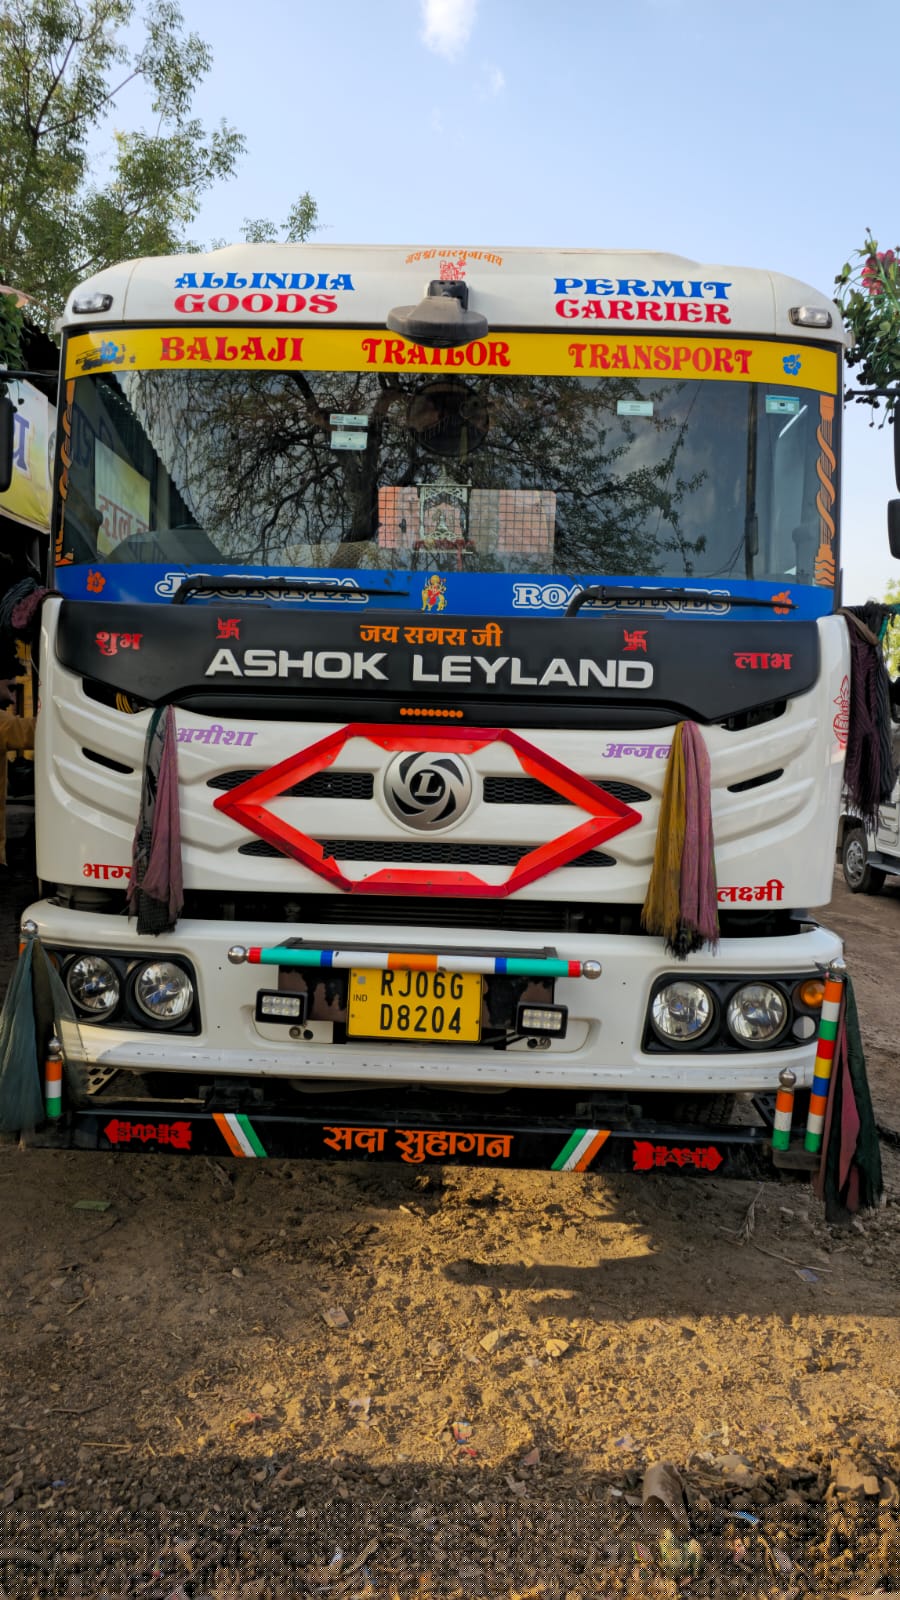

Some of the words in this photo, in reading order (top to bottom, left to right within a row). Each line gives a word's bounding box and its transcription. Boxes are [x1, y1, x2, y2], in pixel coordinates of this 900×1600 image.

[554, 278, 732, 300] PERMIT
[174, 293, 338, 314] GOODS
[555, 299, 732, 325] CARRIER
[160, 336, 304, 362] BALAJI
[361, 338, 511, 367] TRAILOR
[568, 343, 752, 374] TRANSPORT
[95, 631, 144, 656] शुभ
[359, 625, 400, 643] जय
[404, 626, 468, 646] सगस
[471, 622, 504, 647] जी
[204, 648, 388, 681] ASHOK
[412, 654, 654, 689] LEYLAND
[734, 651, 793, 670] लाभ
[176, 724, 258, 747] अमीशा
[414, 772, 442, 797] L
[716, 879, 785, 903] लक्ष्मी
[380, 969, 464, 1000] RJ06G
[353, 993, 368, 1002] IND
[380, 1003, 461, 1034] D8204
[323, 1126, 388, 1153] सदा
[395, 1129, 514, 1164] सुहागन
